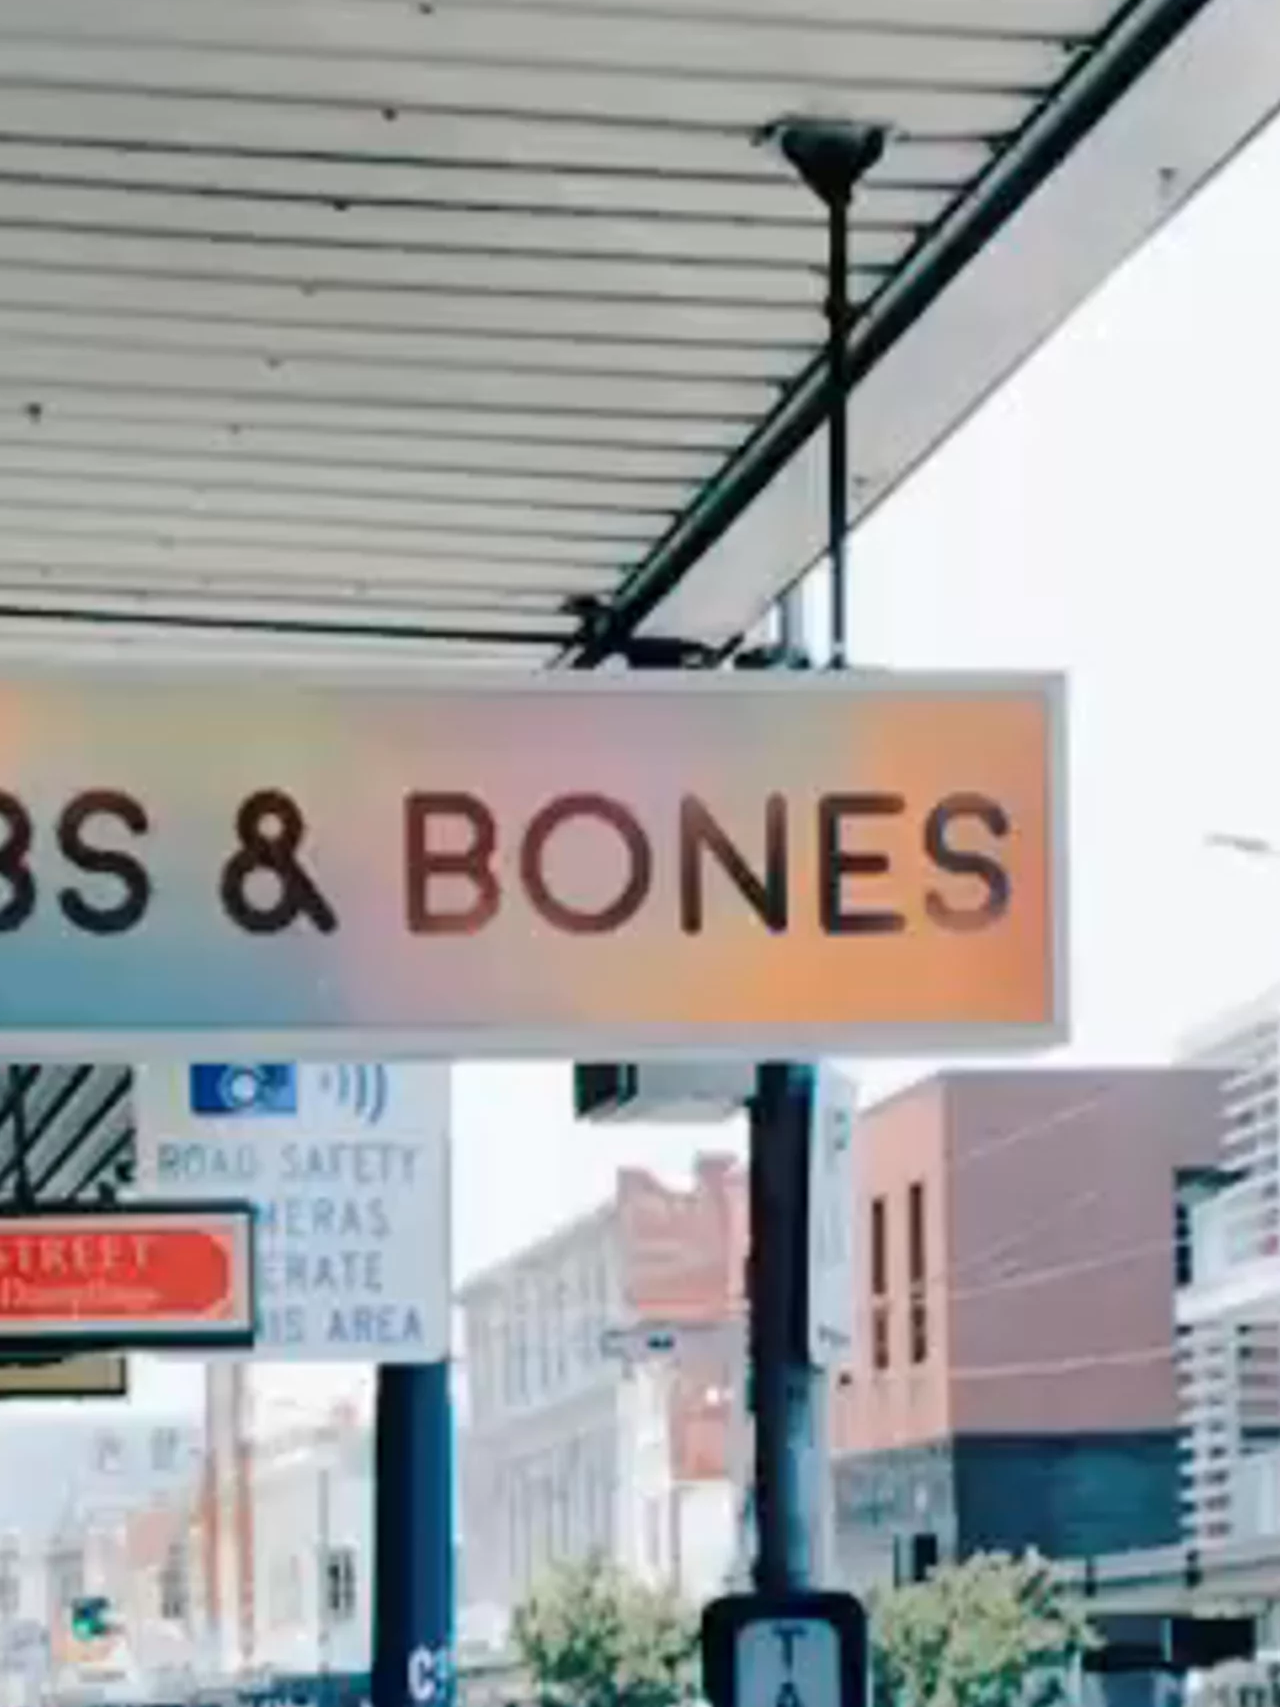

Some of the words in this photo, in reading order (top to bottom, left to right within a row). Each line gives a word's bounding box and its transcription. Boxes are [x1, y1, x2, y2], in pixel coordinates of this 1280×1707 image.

[220, 789, 338, 934] &
[402, 789, 1012, 935] BONES
[157, 1142, 257, 1183] ROAD
[280, 1143, 419, 1184] SAFETY
[265, 1250, 383, 1293] ERATE
[327, 1306, 423, 1342] AREA
